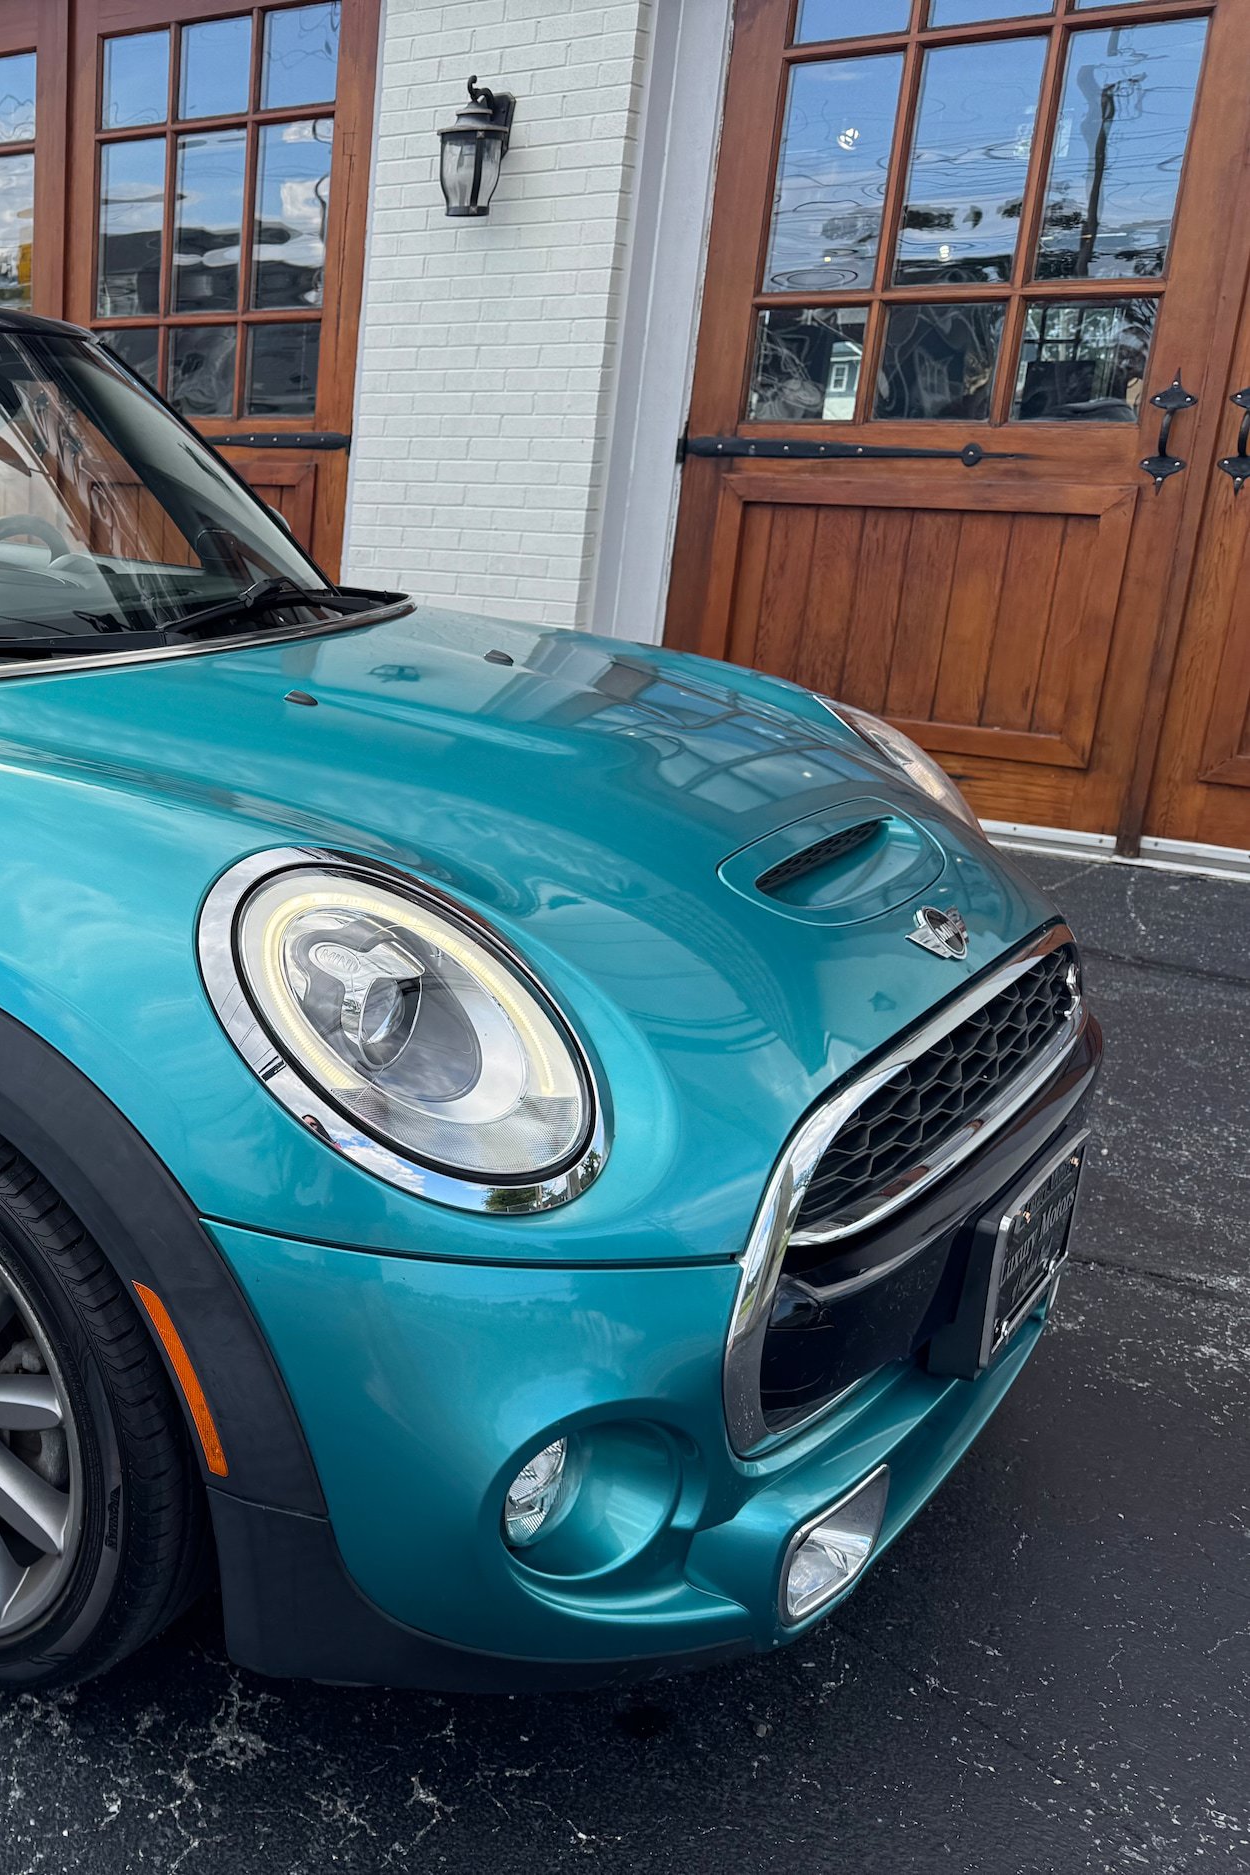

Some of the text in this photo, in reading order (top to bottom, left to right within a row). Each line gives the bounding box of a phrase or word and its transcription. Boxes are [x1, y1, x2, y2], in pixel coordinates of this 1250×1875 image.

[320, 948, 357, 971] MINI
[1000, 1228, 1038, 1287] Luxury
[1039, 1188, 1075, 1239] Motors
